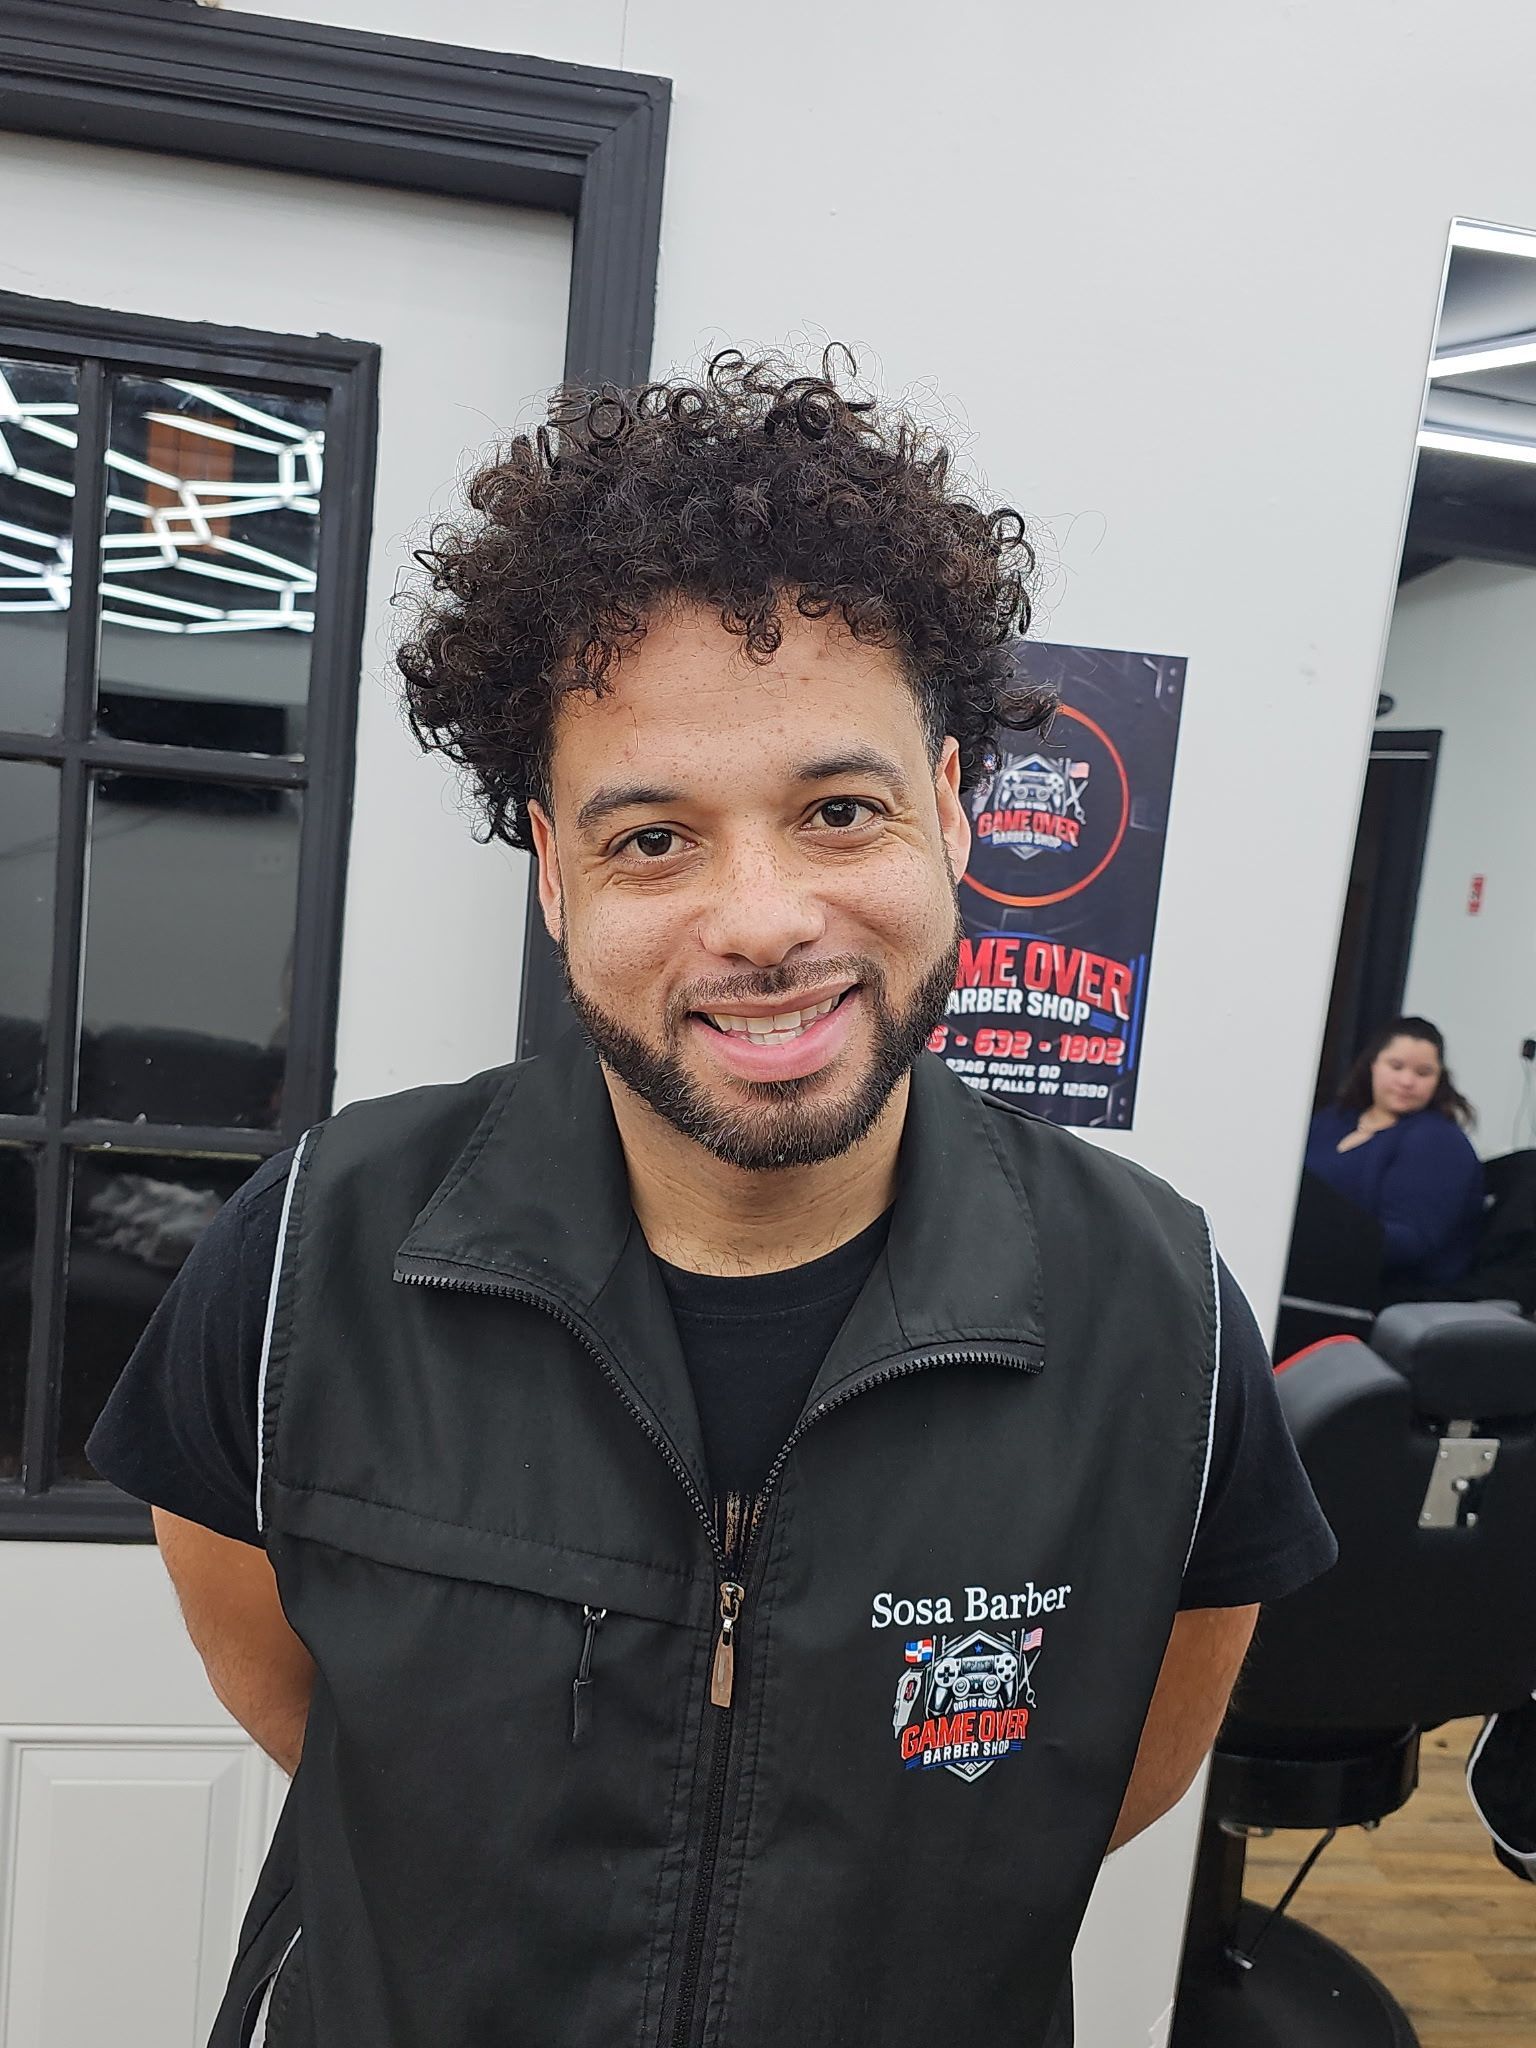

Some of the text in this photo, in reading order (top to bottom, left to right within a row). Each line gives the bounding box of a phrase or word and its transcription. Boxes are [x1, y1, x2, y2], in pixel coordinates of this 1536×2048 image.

[977, 810, 1079, 847] GAME OVER
[955, 938, 1132, 1021] ME OVER
[944, 987, 1090, 1026] ARBER SHOP
[974, 1028, 1032, 1060] 632
[1058, 1033, 1126, 1066] 1802
[987, 1061, 1035, 1078] ROUTE
[991, 1077, 1035, 1095] FALLS
[1038, 1081, 1059, 1097] NY
[871, 1581, 1072, 1629] Sosa Barber
[953, 1698, 998, 1712] GOD IS GOOD
[901, 1708, 1029, 1760] GAME OVER
[923, 1739, 1010, 1765] BARBER SHOP
